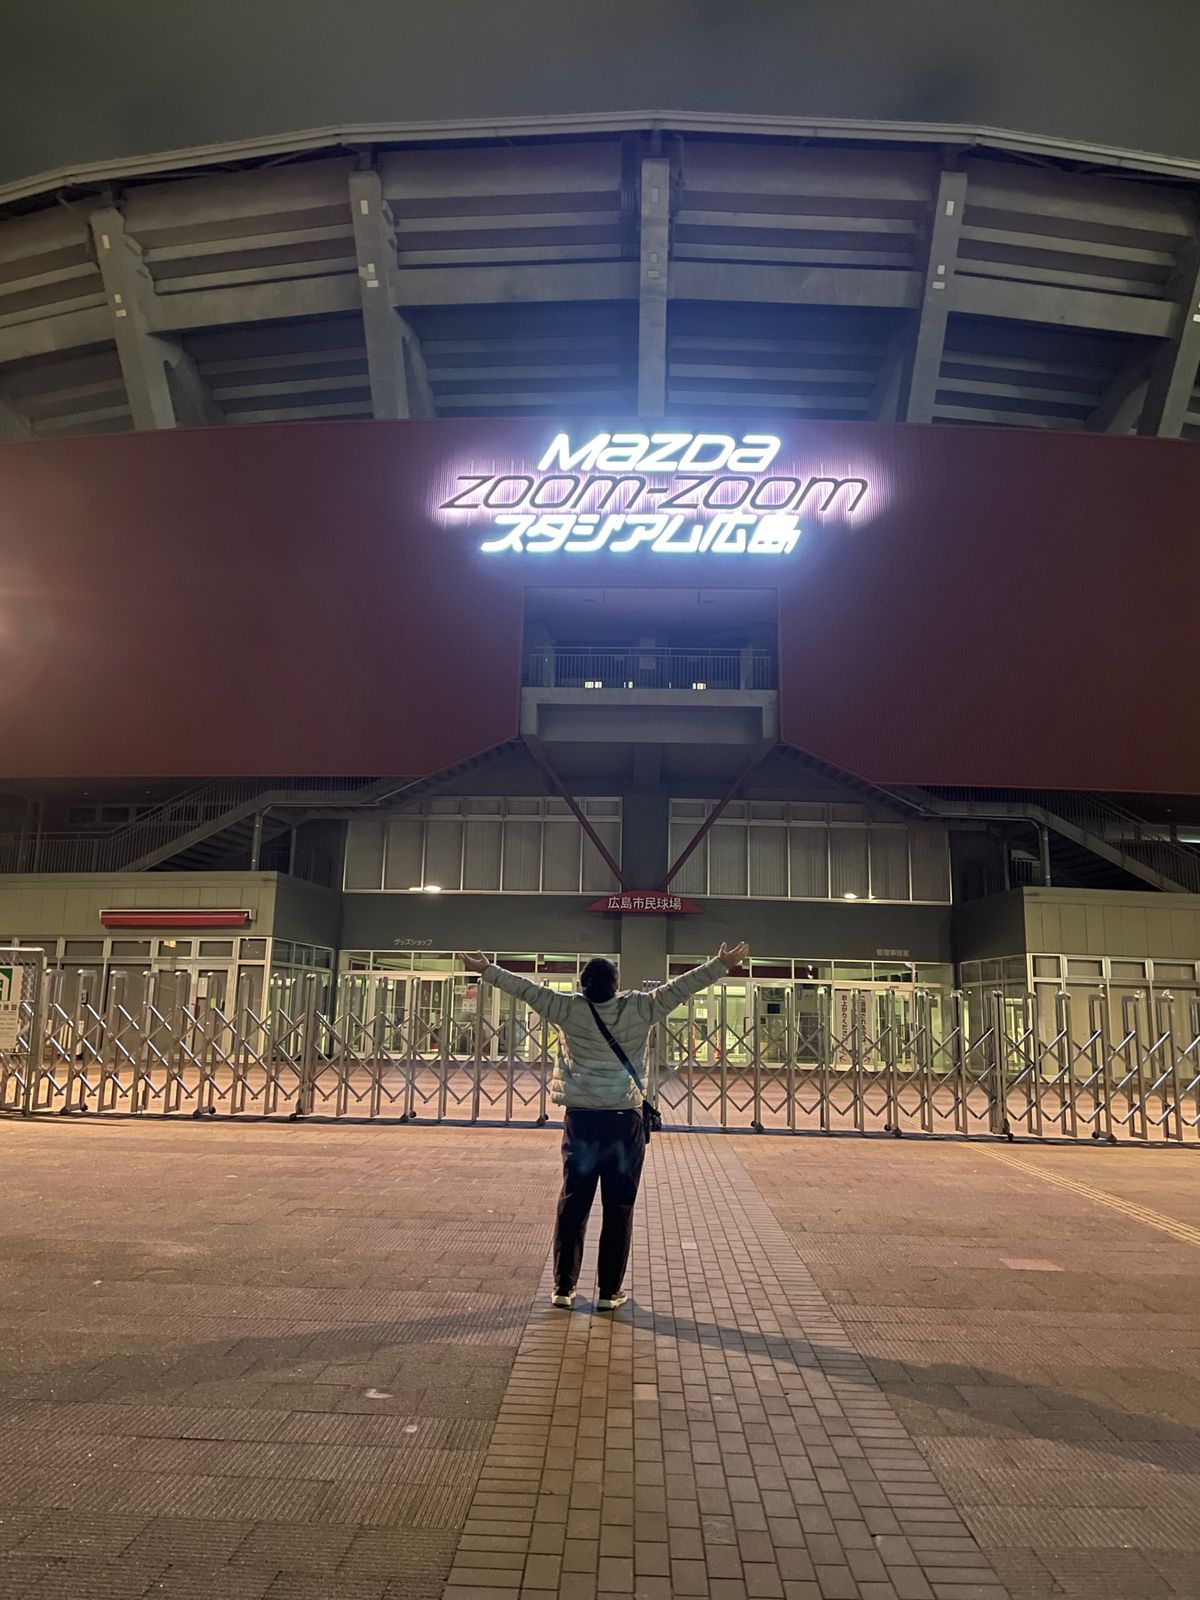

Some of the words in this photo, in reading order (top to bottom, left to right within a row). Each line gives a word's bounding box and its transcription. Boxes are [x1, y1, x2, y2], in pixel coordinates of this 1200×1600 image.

[480, 510, 802, 555] スタジアム広島
[607, 896, 682, 910] 広島市民球場
[393, 938, 433, 946] グッズショップ
